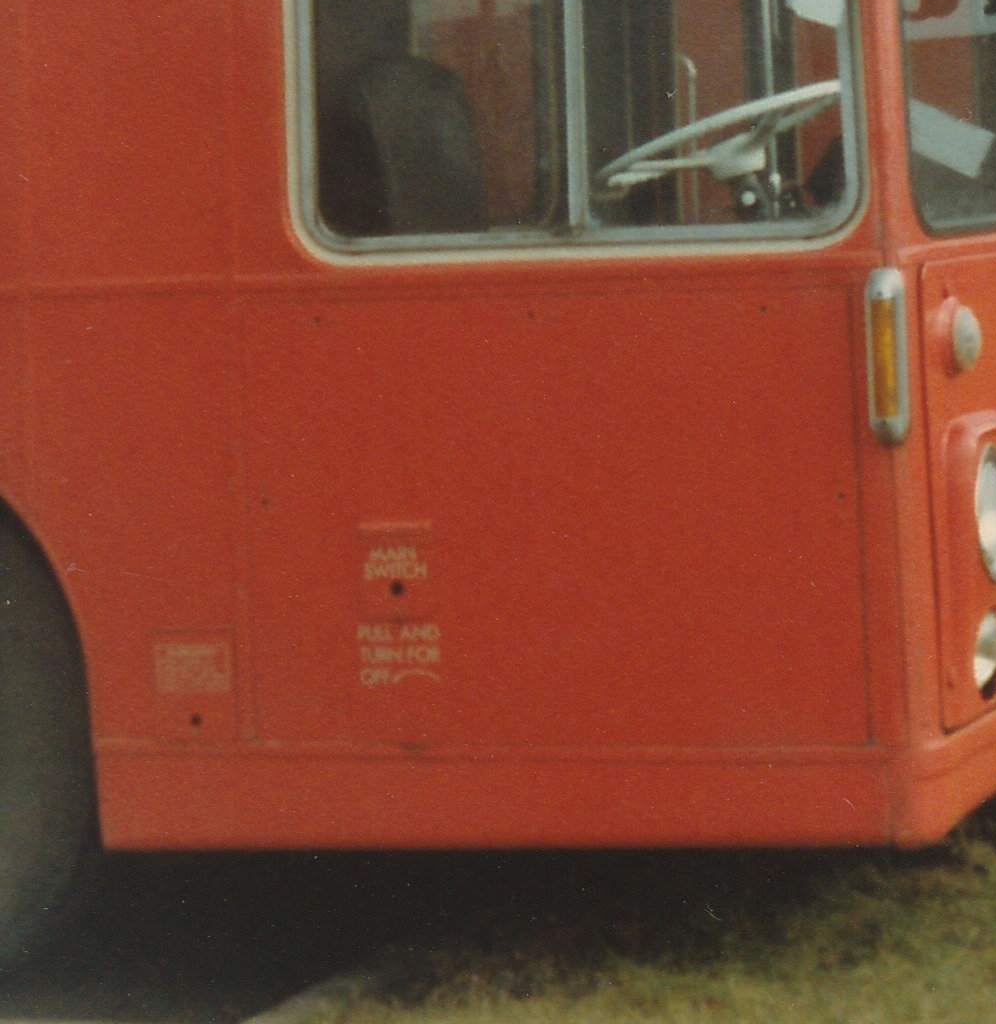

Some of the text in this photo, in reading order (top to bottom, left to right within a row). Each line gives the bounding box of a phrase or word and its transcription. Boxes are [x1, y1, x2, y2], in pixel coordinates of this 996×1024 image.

[369, 546, 418, 562] MAIN
[363, 562, 427, 580] SWITCH
[357, 623, 441, 642] PULL AND
[360, 645, 440, 664] TURN FOR
[360, 668, 389, 688] OFF
